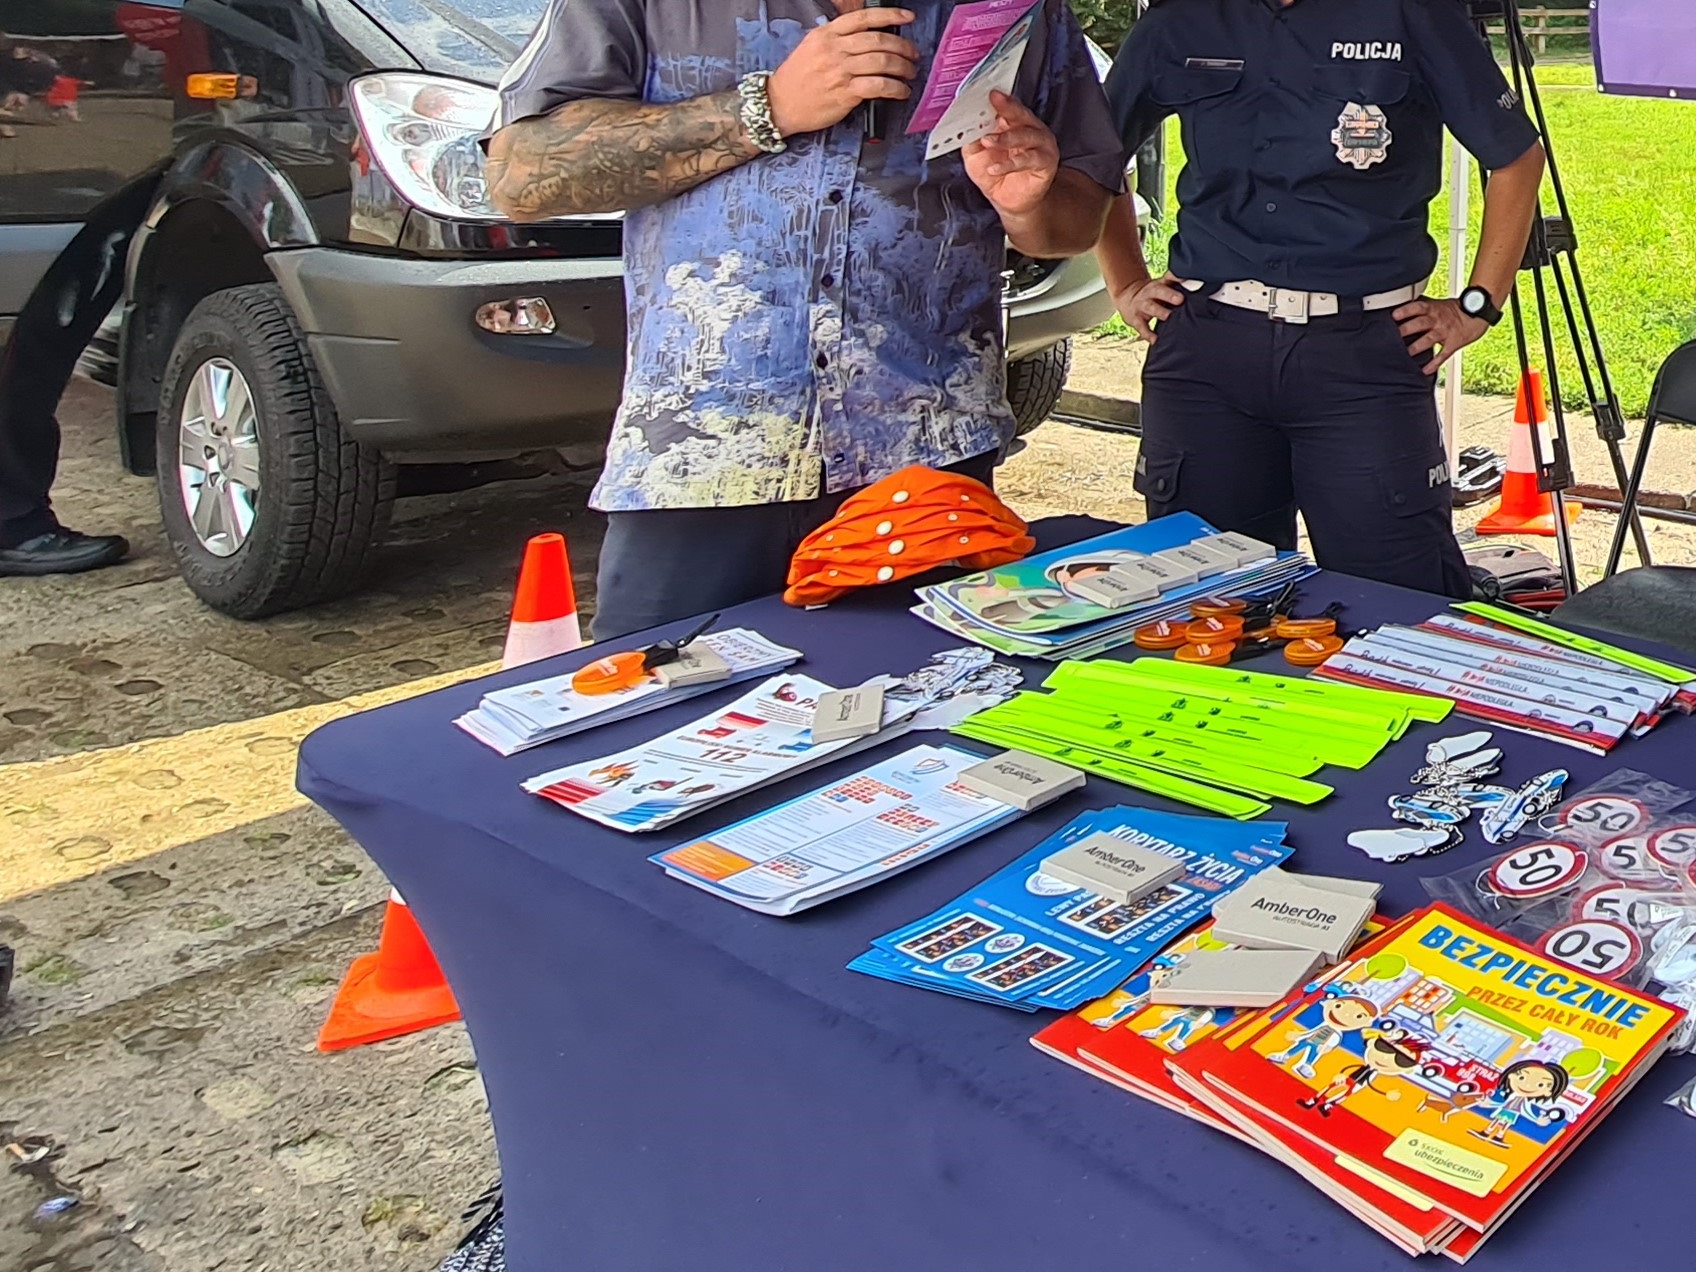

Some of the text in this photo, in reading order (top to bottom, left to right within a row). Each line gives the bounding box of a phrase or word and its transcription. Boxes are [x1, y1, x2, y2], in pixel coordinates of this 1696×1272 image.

[1331, 42, 1402, 62] POLICJA
[699, 748, 747, 763] 112
[1571, 801, 1635, 831] 50
[1084, 846, 1146, 874] AmberOne
[1195, 852, 1245, 886] ŻYCIA
[1508, 848, 1563, 886] 50
[1250, 897, 1337, 924] AmberOne
[1112, 919, 1154, 945] RESZTA
[1552, 930, 1627, 970] 50
[1418, 925, 1650, 1029] BEZPIECZNIE
[1466, 986, 1624, 1041] PRZEZ CAŁY ROK
[1414, 1148, 1485, 1180] ubezpieczenia
